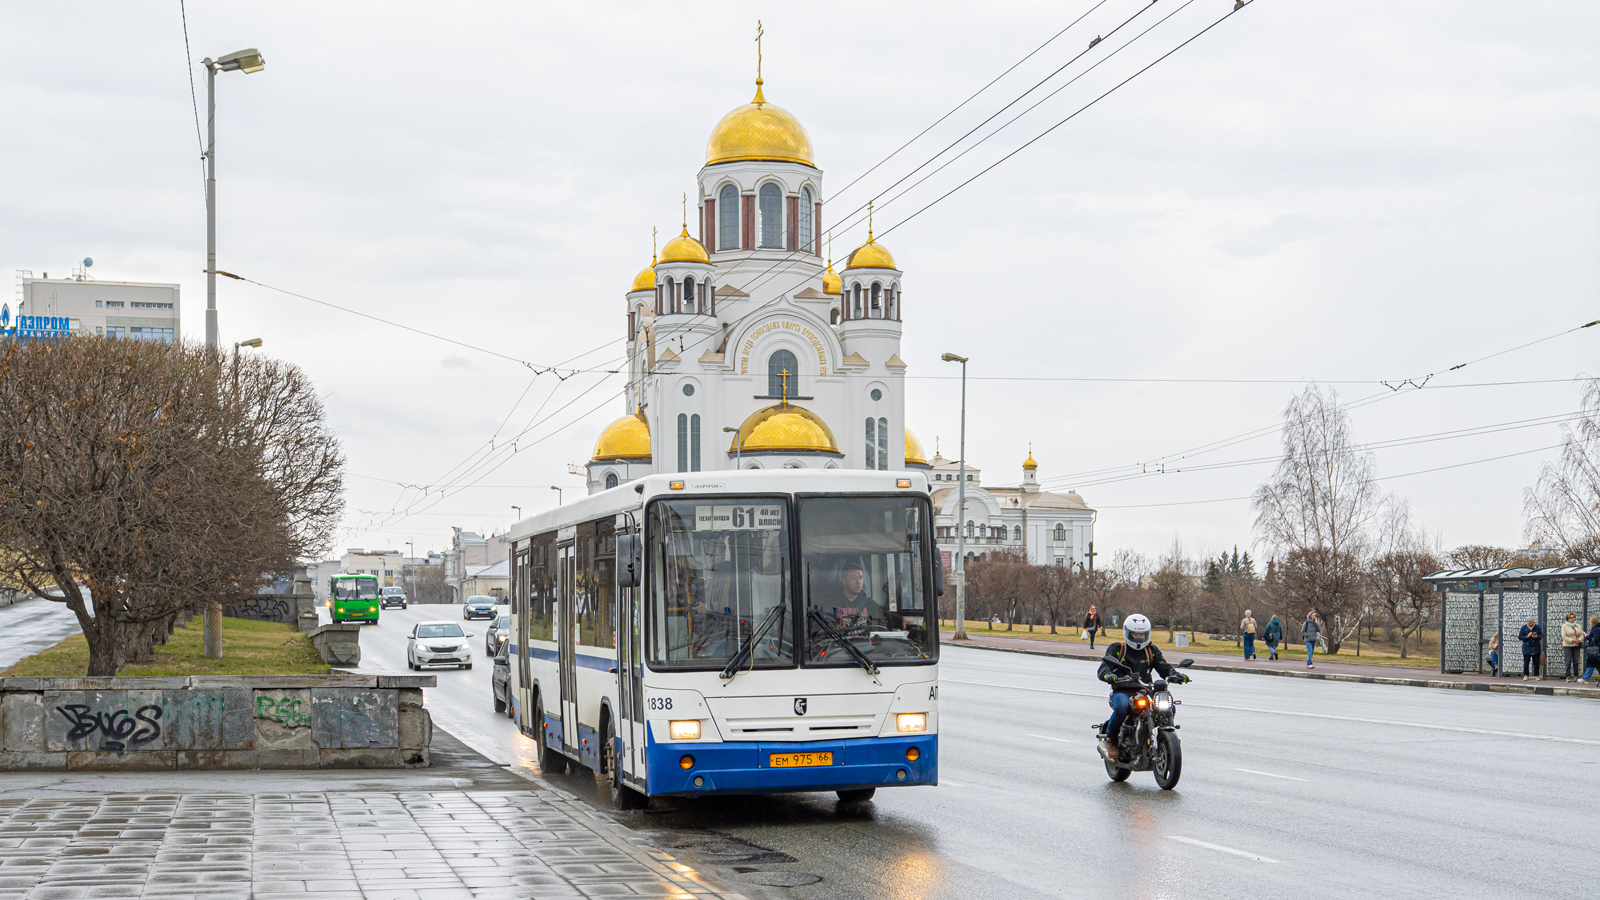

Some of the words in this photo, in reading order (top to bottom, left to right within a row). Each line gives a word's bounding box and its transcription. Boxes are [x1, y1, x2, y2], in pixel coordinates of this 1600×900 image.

[16, 315, 70, 330] ГАЗПРОМ
[732, 506, 755, 528] 61
[760, 508, 768, 516] 40
[647, 697, 673, 710] 1838
[775, 757, 789, 766] ЕМ
[792, 754, 813, 766] 975
[818, 753, 829, 762] 66
